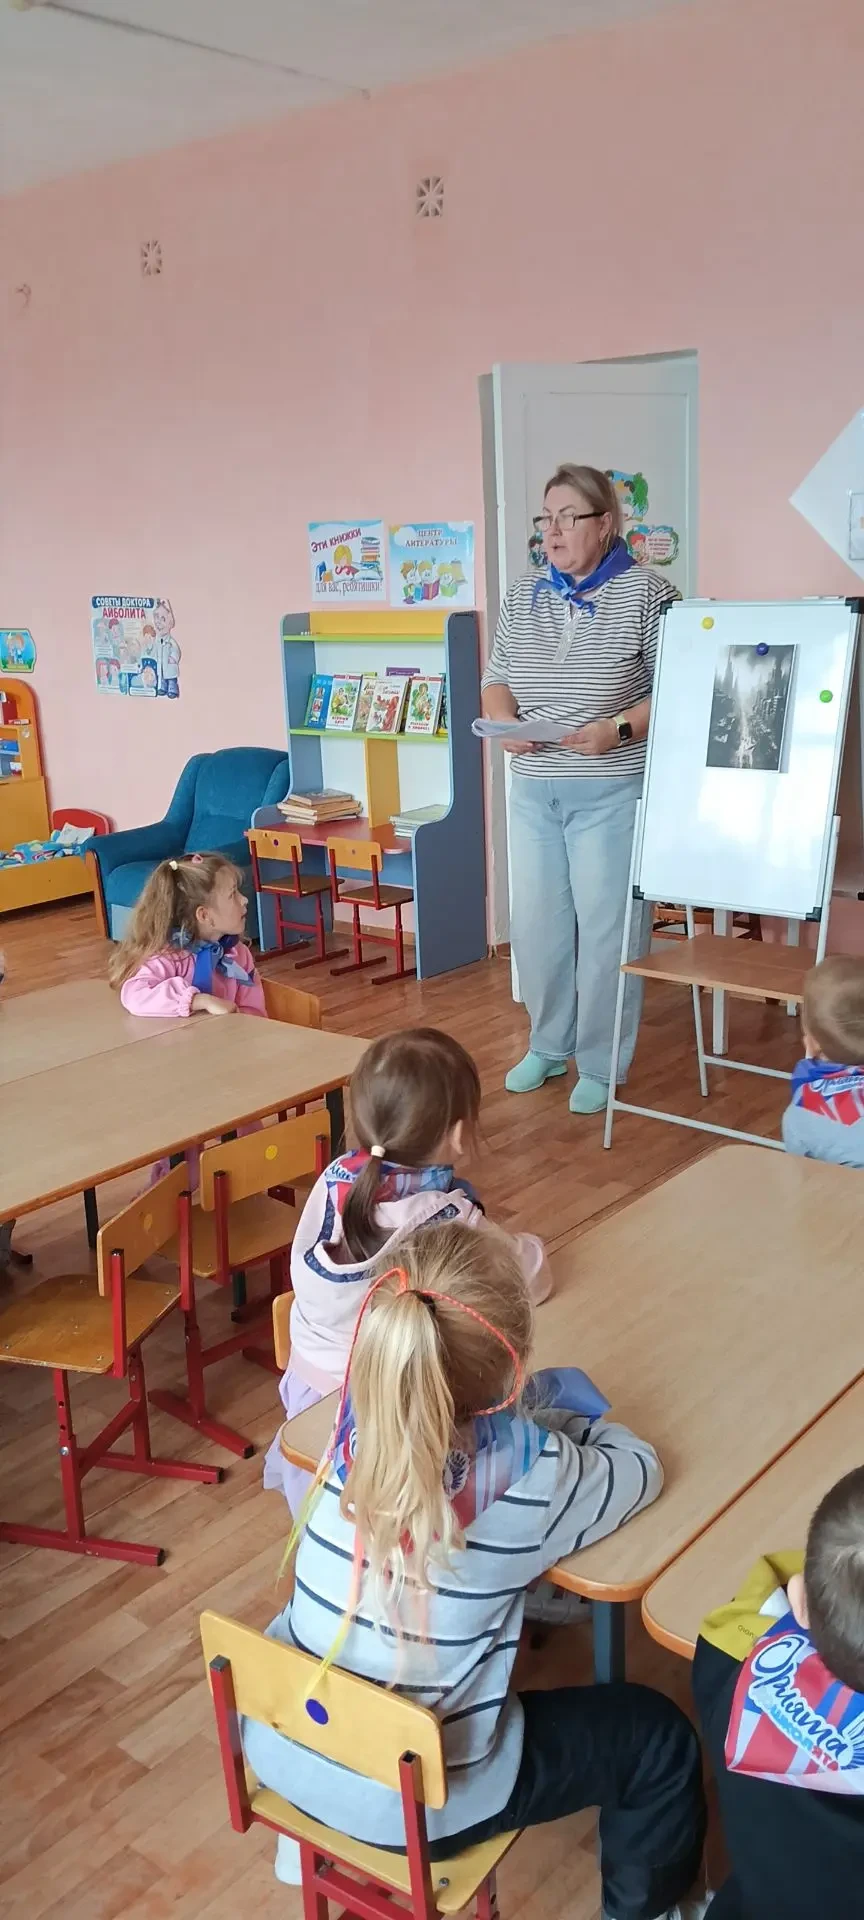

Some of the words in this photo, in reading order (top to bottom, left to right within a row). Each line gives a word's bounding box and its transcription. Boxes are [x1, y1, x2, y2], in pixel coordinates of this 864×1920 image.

[418, 529, 443, 538] ЦЕНТР
[311, 541, 328, 553] ЭТИ
[329, 527, 362, 547] КНИЖКИ
[405, 538, 457, 547] ЛИТЕРАТУРЫ
[96, 596, 121, 606] СОВЕТЫ
[122, 597, 152, 607] ДОКТОРА
